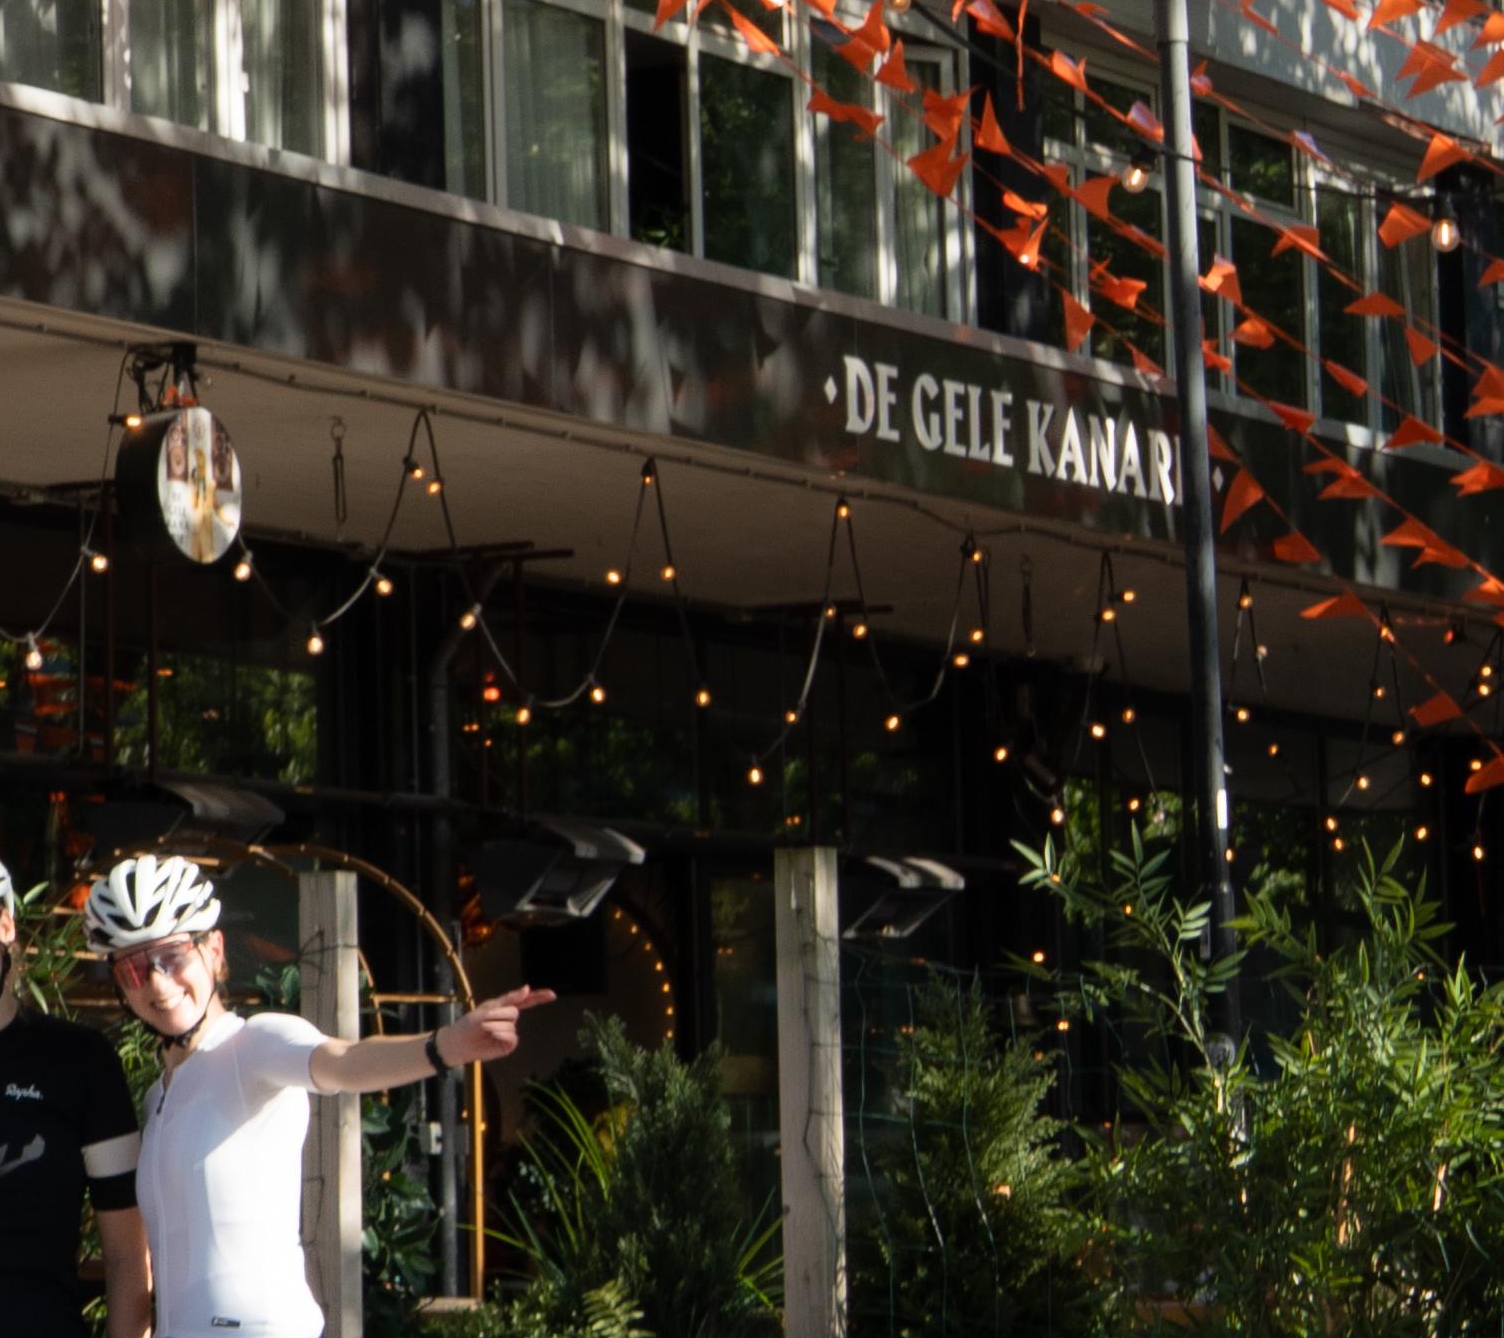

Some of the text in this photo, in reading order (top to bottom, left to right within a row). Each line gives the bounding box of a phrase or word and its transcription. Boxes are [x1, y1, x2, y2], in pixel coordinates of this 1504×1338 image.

[843, 354, 1184, 506] DE GELE KANARI
